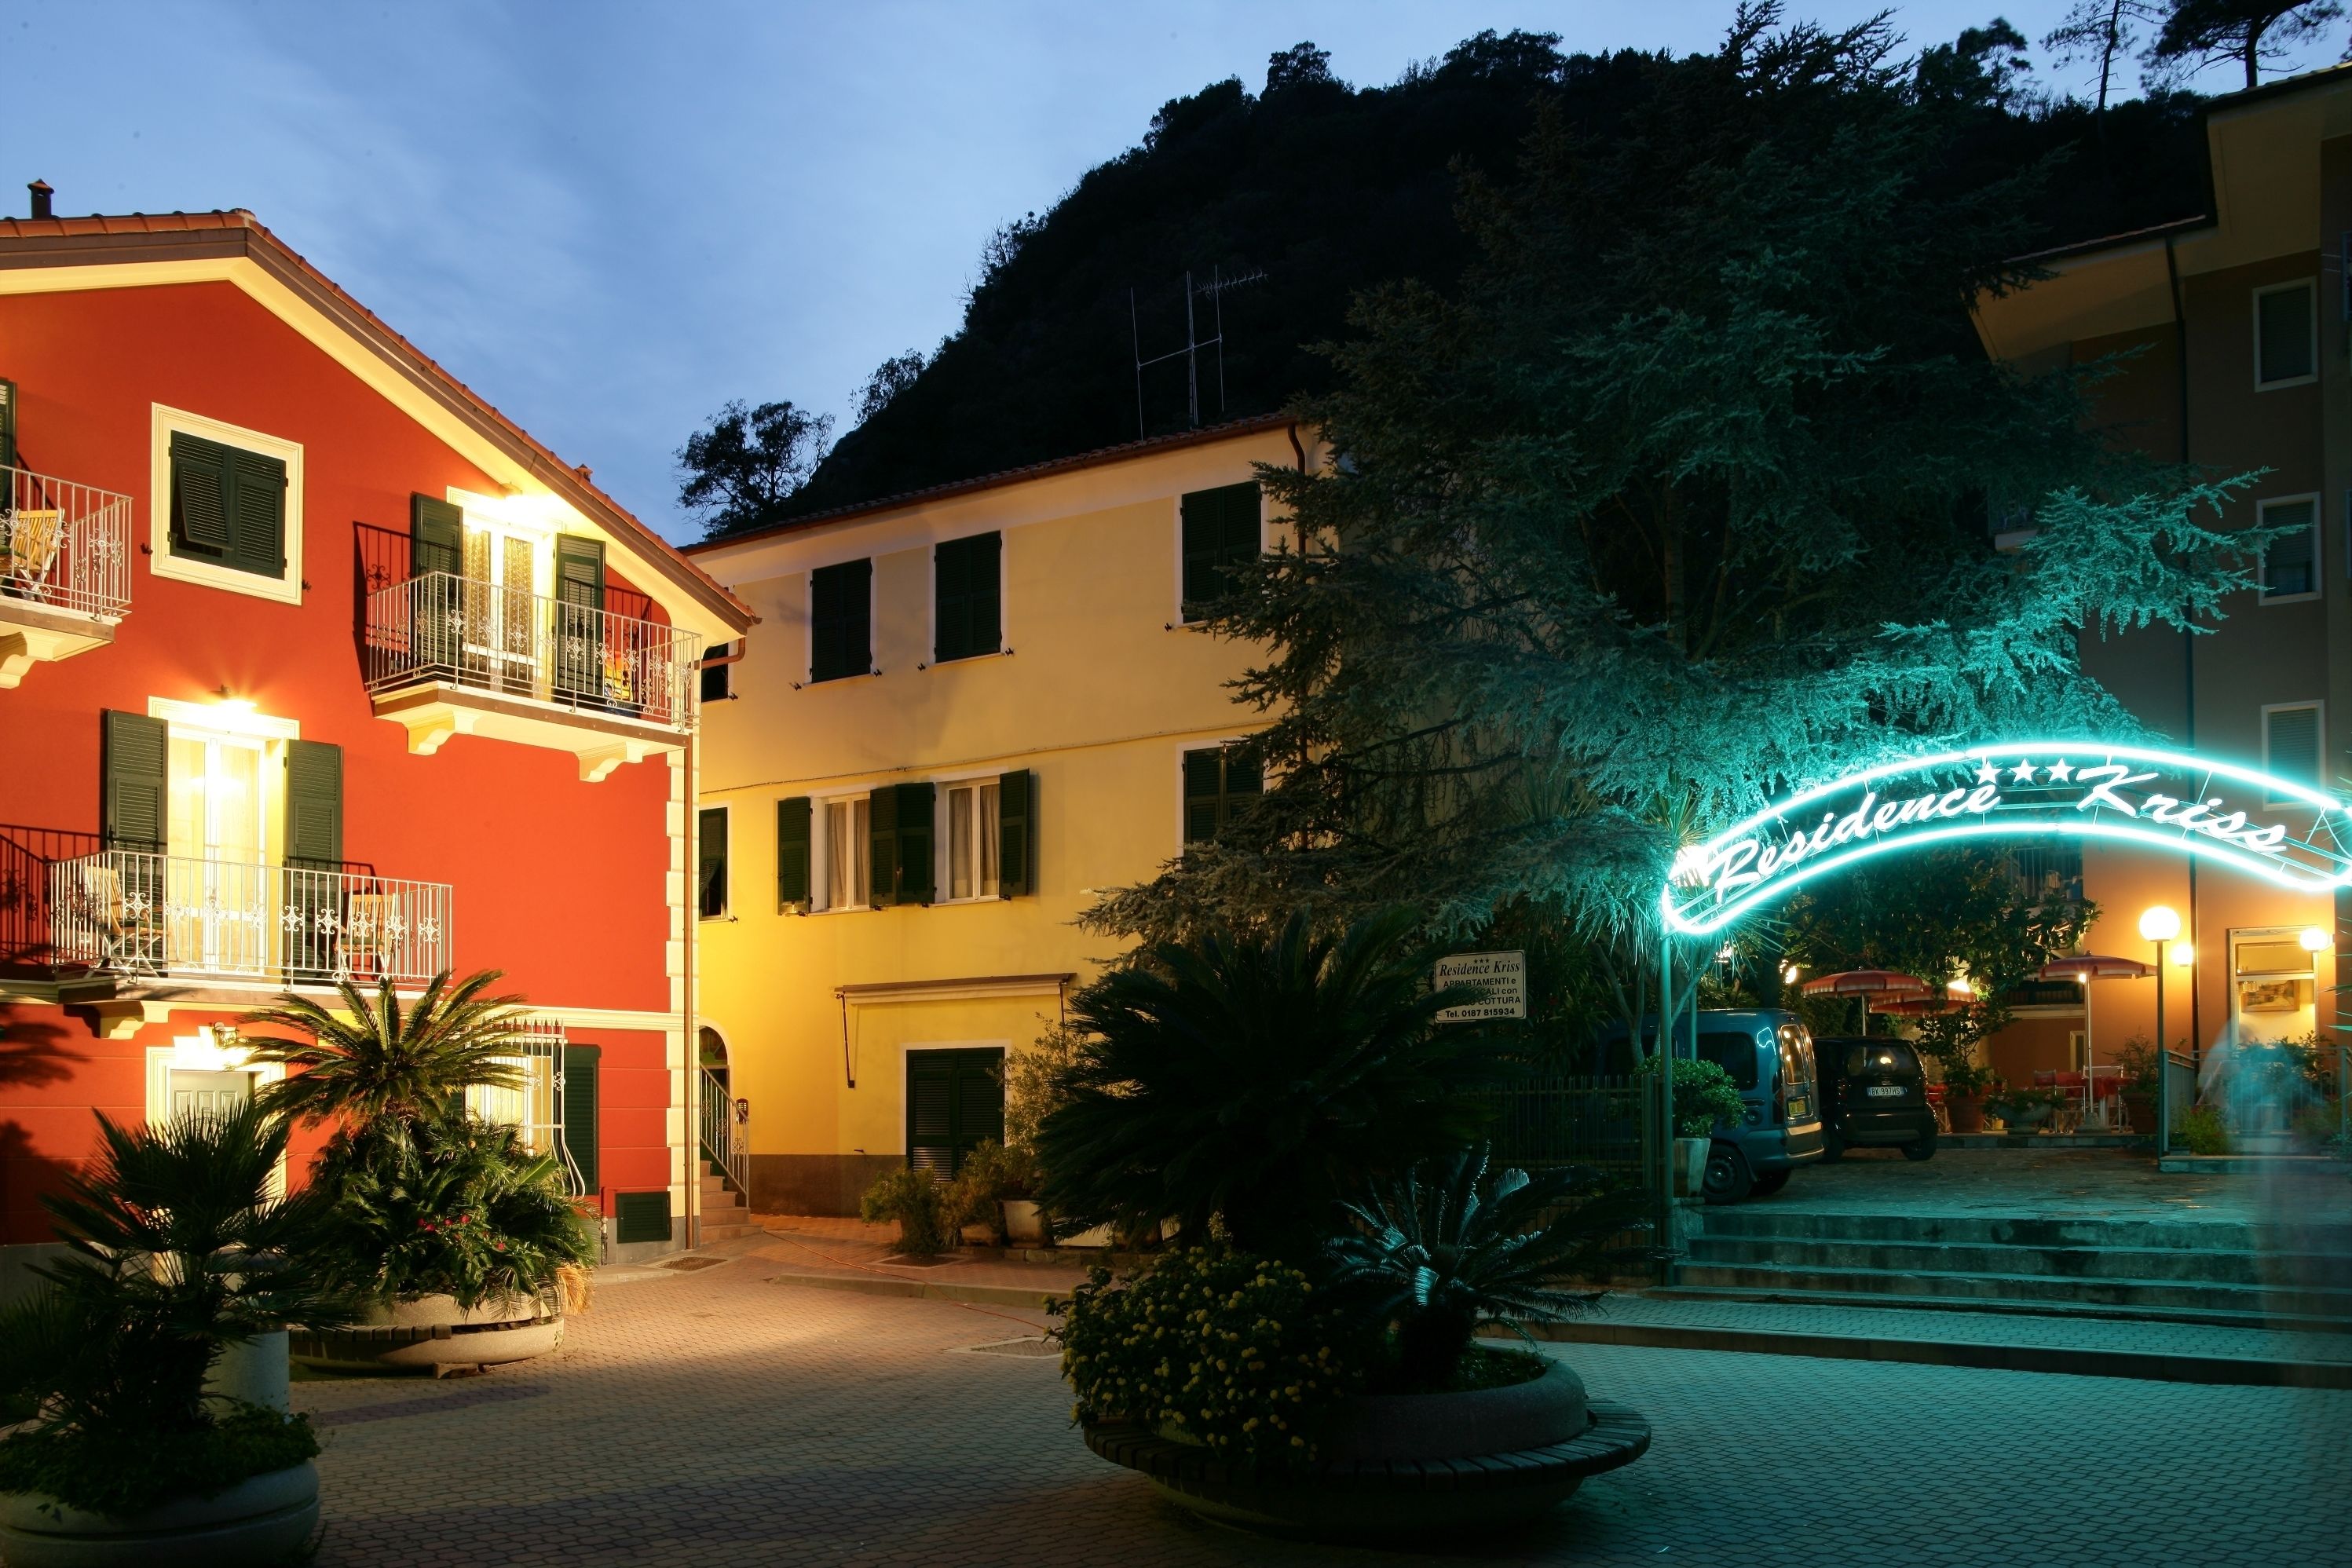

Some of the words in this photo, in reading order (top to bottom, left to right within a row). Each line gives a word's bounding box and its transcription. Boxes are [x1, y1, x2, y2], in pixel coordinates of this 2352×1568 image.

[1703, 784, 2002, 905] Residence
[2075, 763, 2288, 853] Kriss
[1439, 963, 1490, 977] Residence
[1494, 960, 1520, 973] Kriss
[1443, 978, 1509, 988] APPARTAMENTI
[1478, 996, 1521, 1005] COTTURA
[1445, 1010, 1460, 1018] Tel.
[1462, 1009, 1481, 1018] 0187
[1483, 1007, 1515, 1017] 815934
